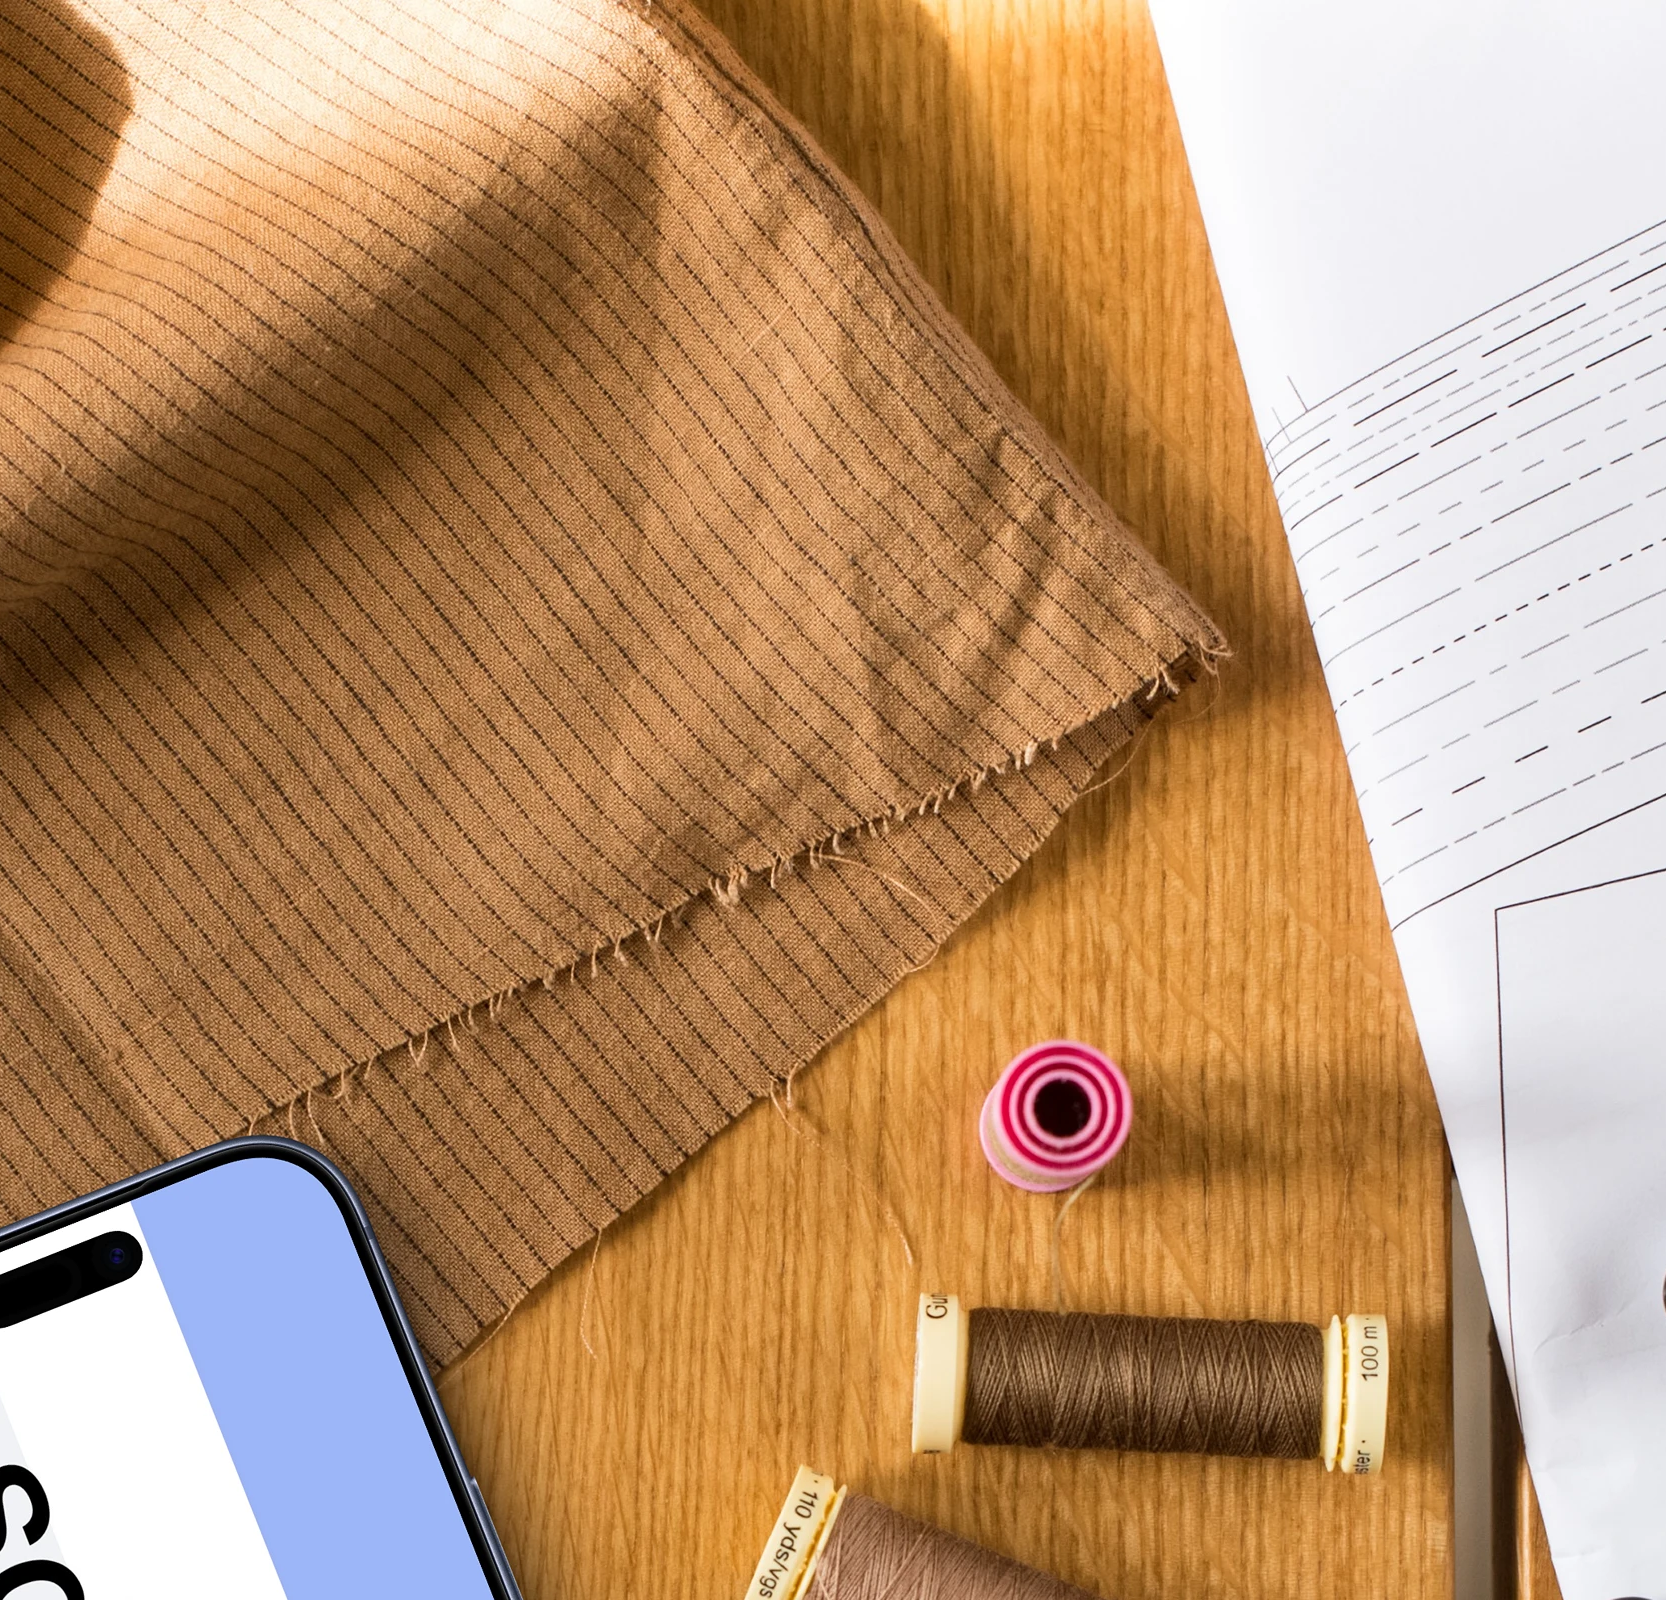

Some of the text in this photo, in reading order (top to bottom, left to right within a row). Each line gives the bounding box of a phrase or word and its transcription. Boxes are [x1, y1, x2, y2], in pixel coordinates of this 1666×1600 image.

[1361, 1326, 1379, 1382] 100 m
[795, 1491, 818, 1519] 110
[759, 1522, 800, 1598] yds/vgs
